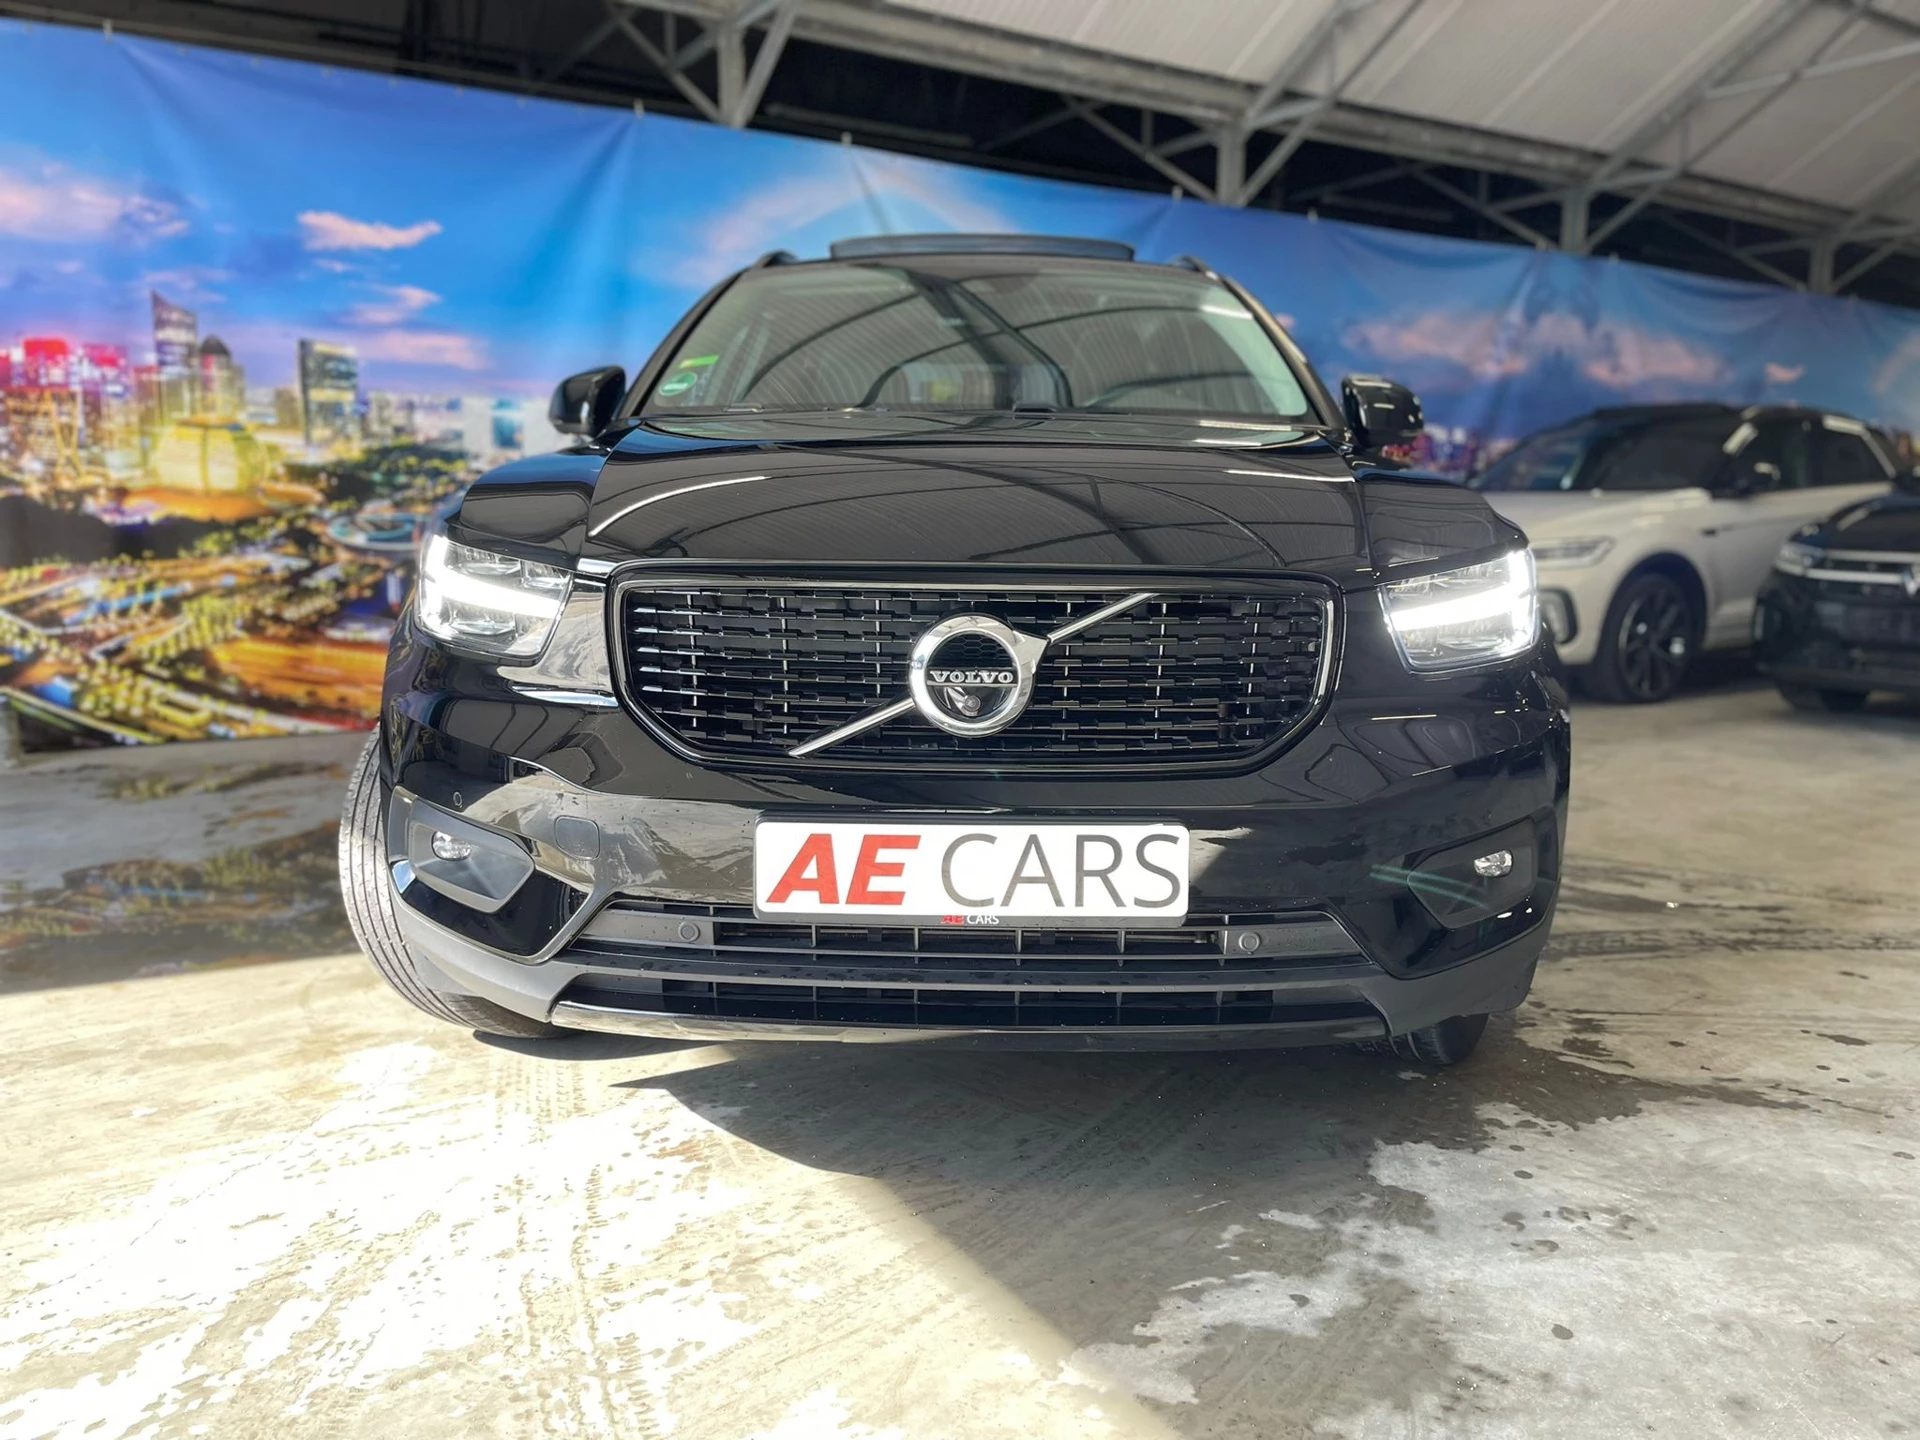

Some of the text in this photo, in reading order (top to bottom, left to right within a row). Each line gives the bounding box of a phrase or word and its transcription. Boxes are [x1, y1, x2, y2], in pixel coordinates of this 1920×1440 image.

[929, 670, 1014, 684] VOLVO
[765, 832, 1182, 908] AE CARS
[940, 913, 1000, 926] AE CARS
